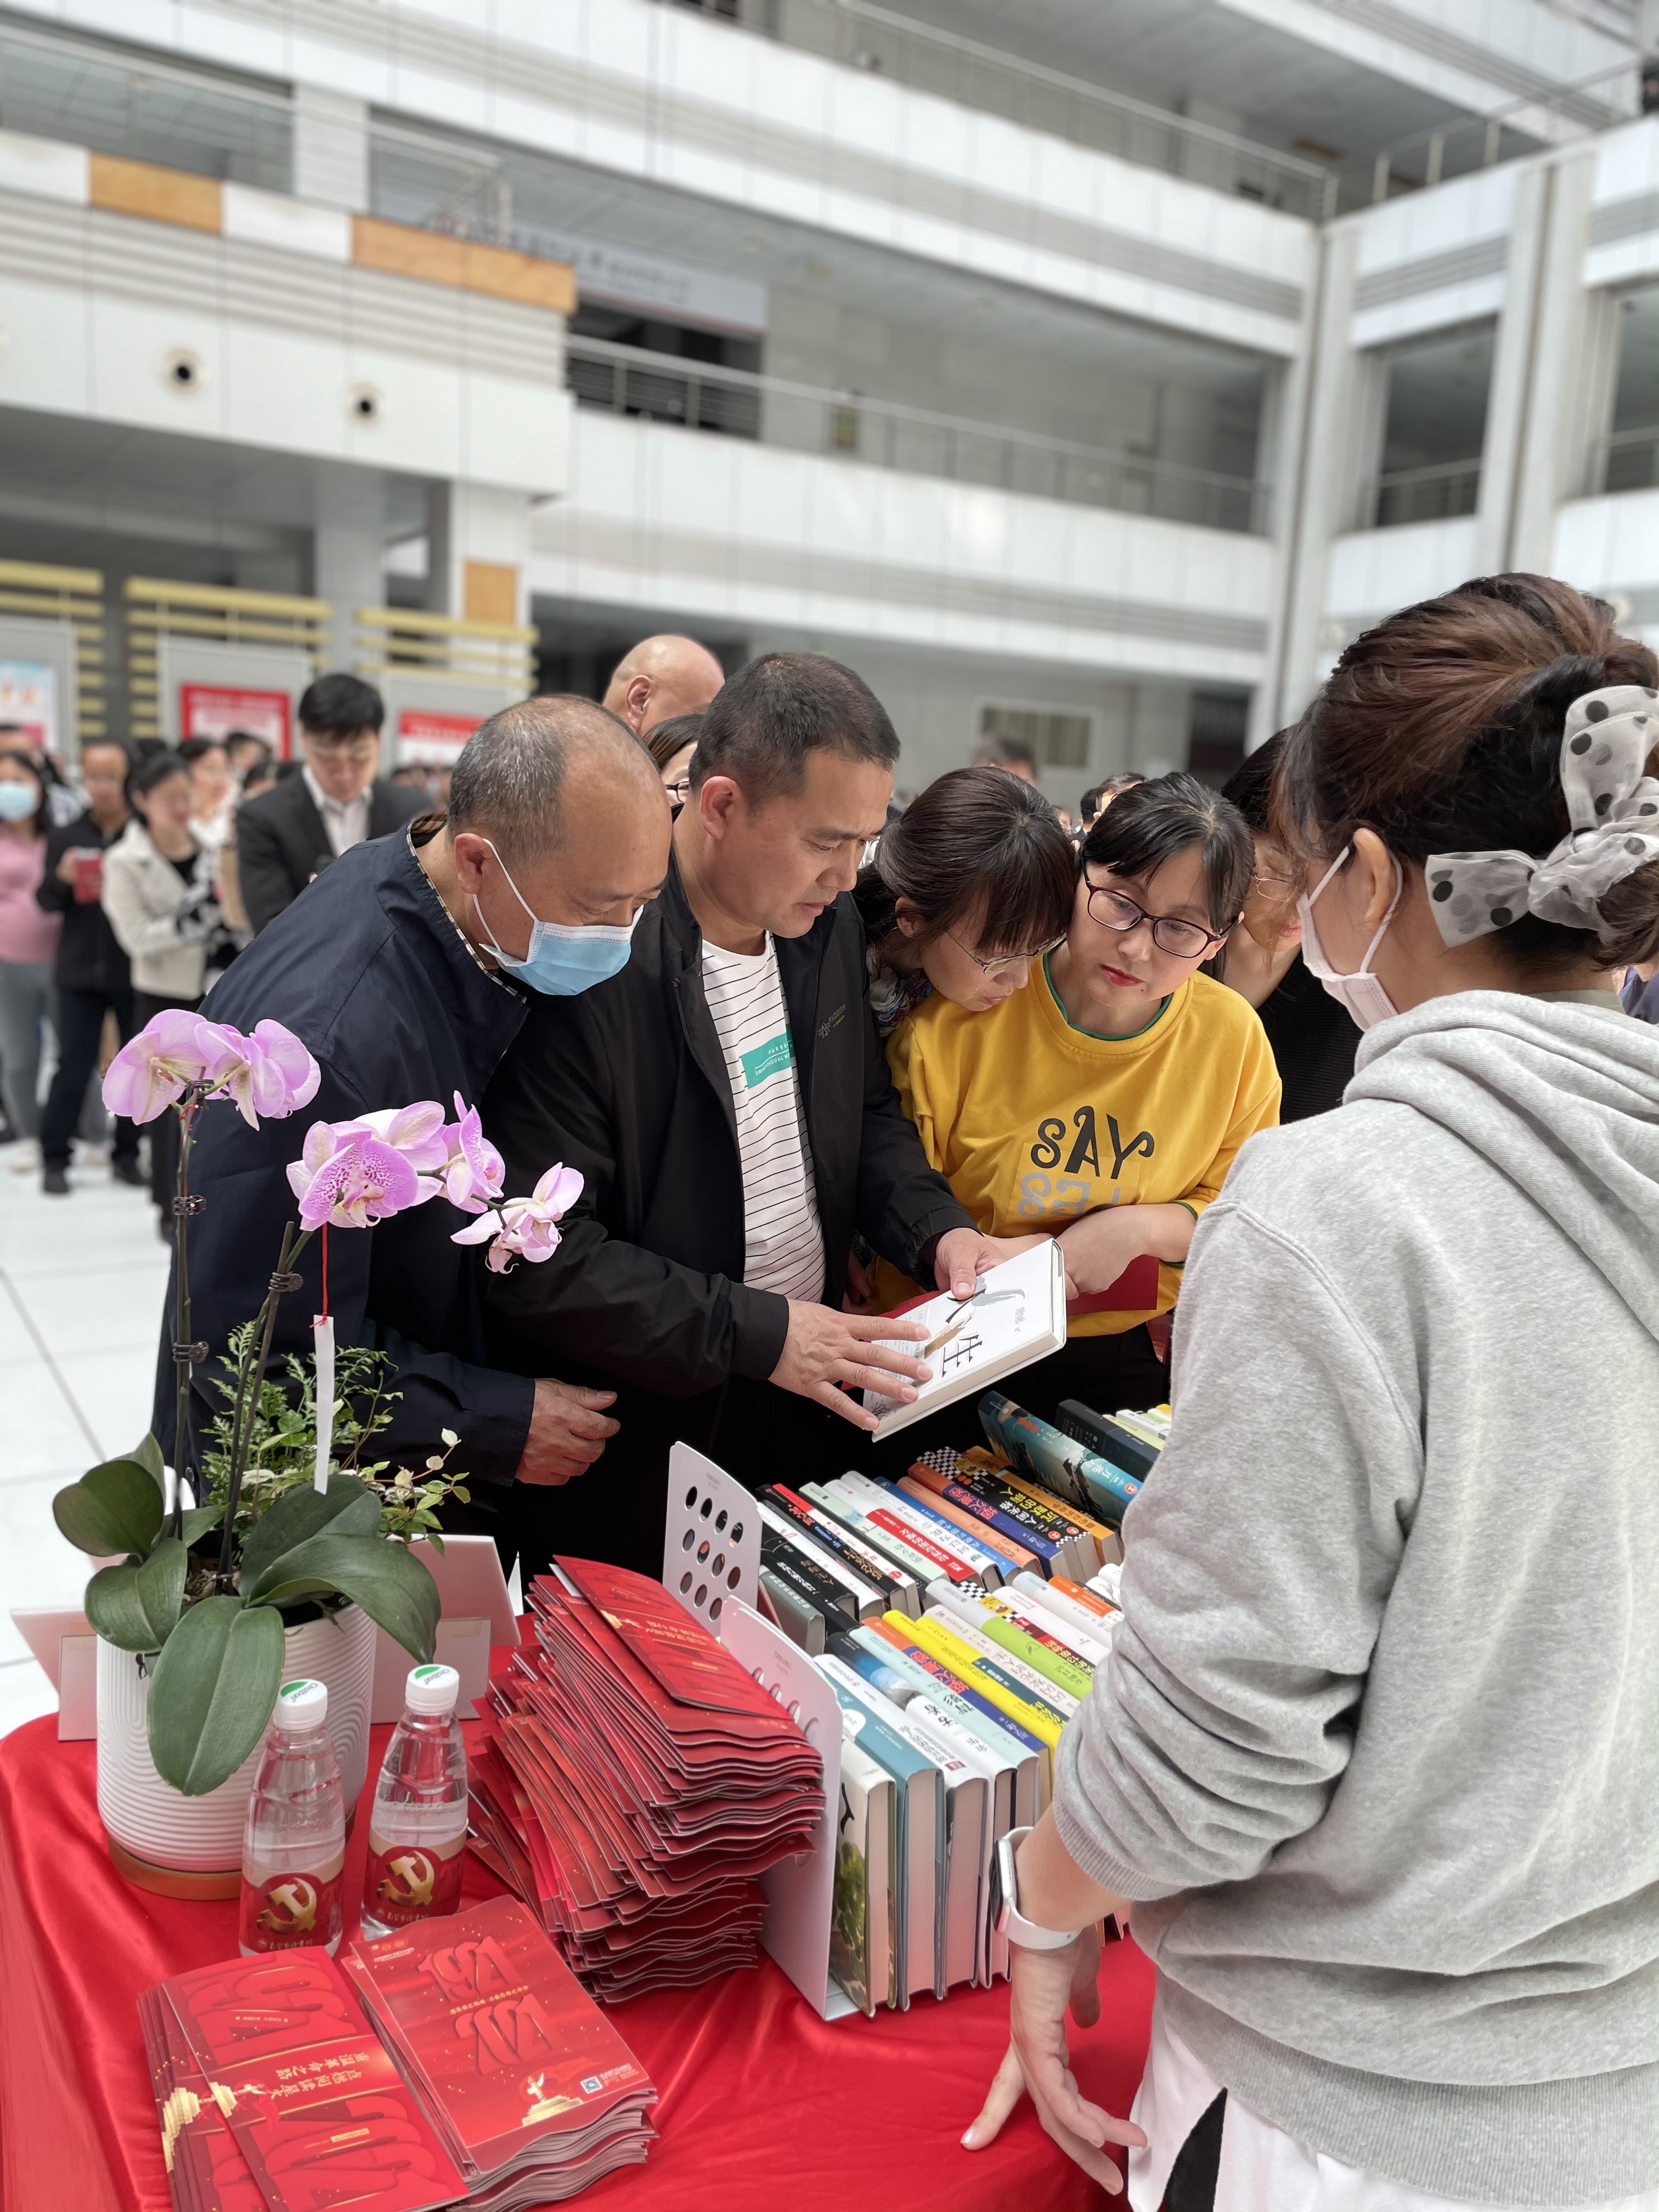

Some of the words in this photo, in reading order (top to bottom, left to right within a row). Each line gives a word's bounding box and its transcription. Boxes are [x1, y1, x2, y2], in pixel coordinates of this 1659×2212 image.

[1031, 1105, 1155, 1180] SAY
[1060, 1443, 1113, 1479] 月亮与六便士
[787, 1506, 814, 1526] 刘心武
[948, 1486, 998, 1520] 烟火漫卷
[998, 1486, 1059, 1523] 沉默的病人
[998, 1500, 1036, 1523] 人间失格
[1051, 1503, 1096, 1528] 撒哈拉的故事
[899, 1530, 949, 1562] 拉普拉斯的魔女
[929, 1529, 970, 1555] 何以为我
[936, 1518, 979, 1548] 夜晚的潜水艇
[1028, 1536, 1046, 1549] 迟子建
[894, 1543, 923, 1564] 朝花夕拾
[799, 1560, 833, 1583] 人生海海
[910, 1653, 969, 1694] 烟火漫卷
[992, 1651, 1065, 1702] 闪闪发光的人生
[1055, 1666, 1082, 1684] 安妮日记
[924, 1705, 958, 1725] 活着
[943, 1695, 974, 1715] 背影
[966, 1736, 986, 1751] 余华
[275, 2051, 370, 2081] 重温革命之路
[269, 2068, 362, 2099] 点燃阅读星火
